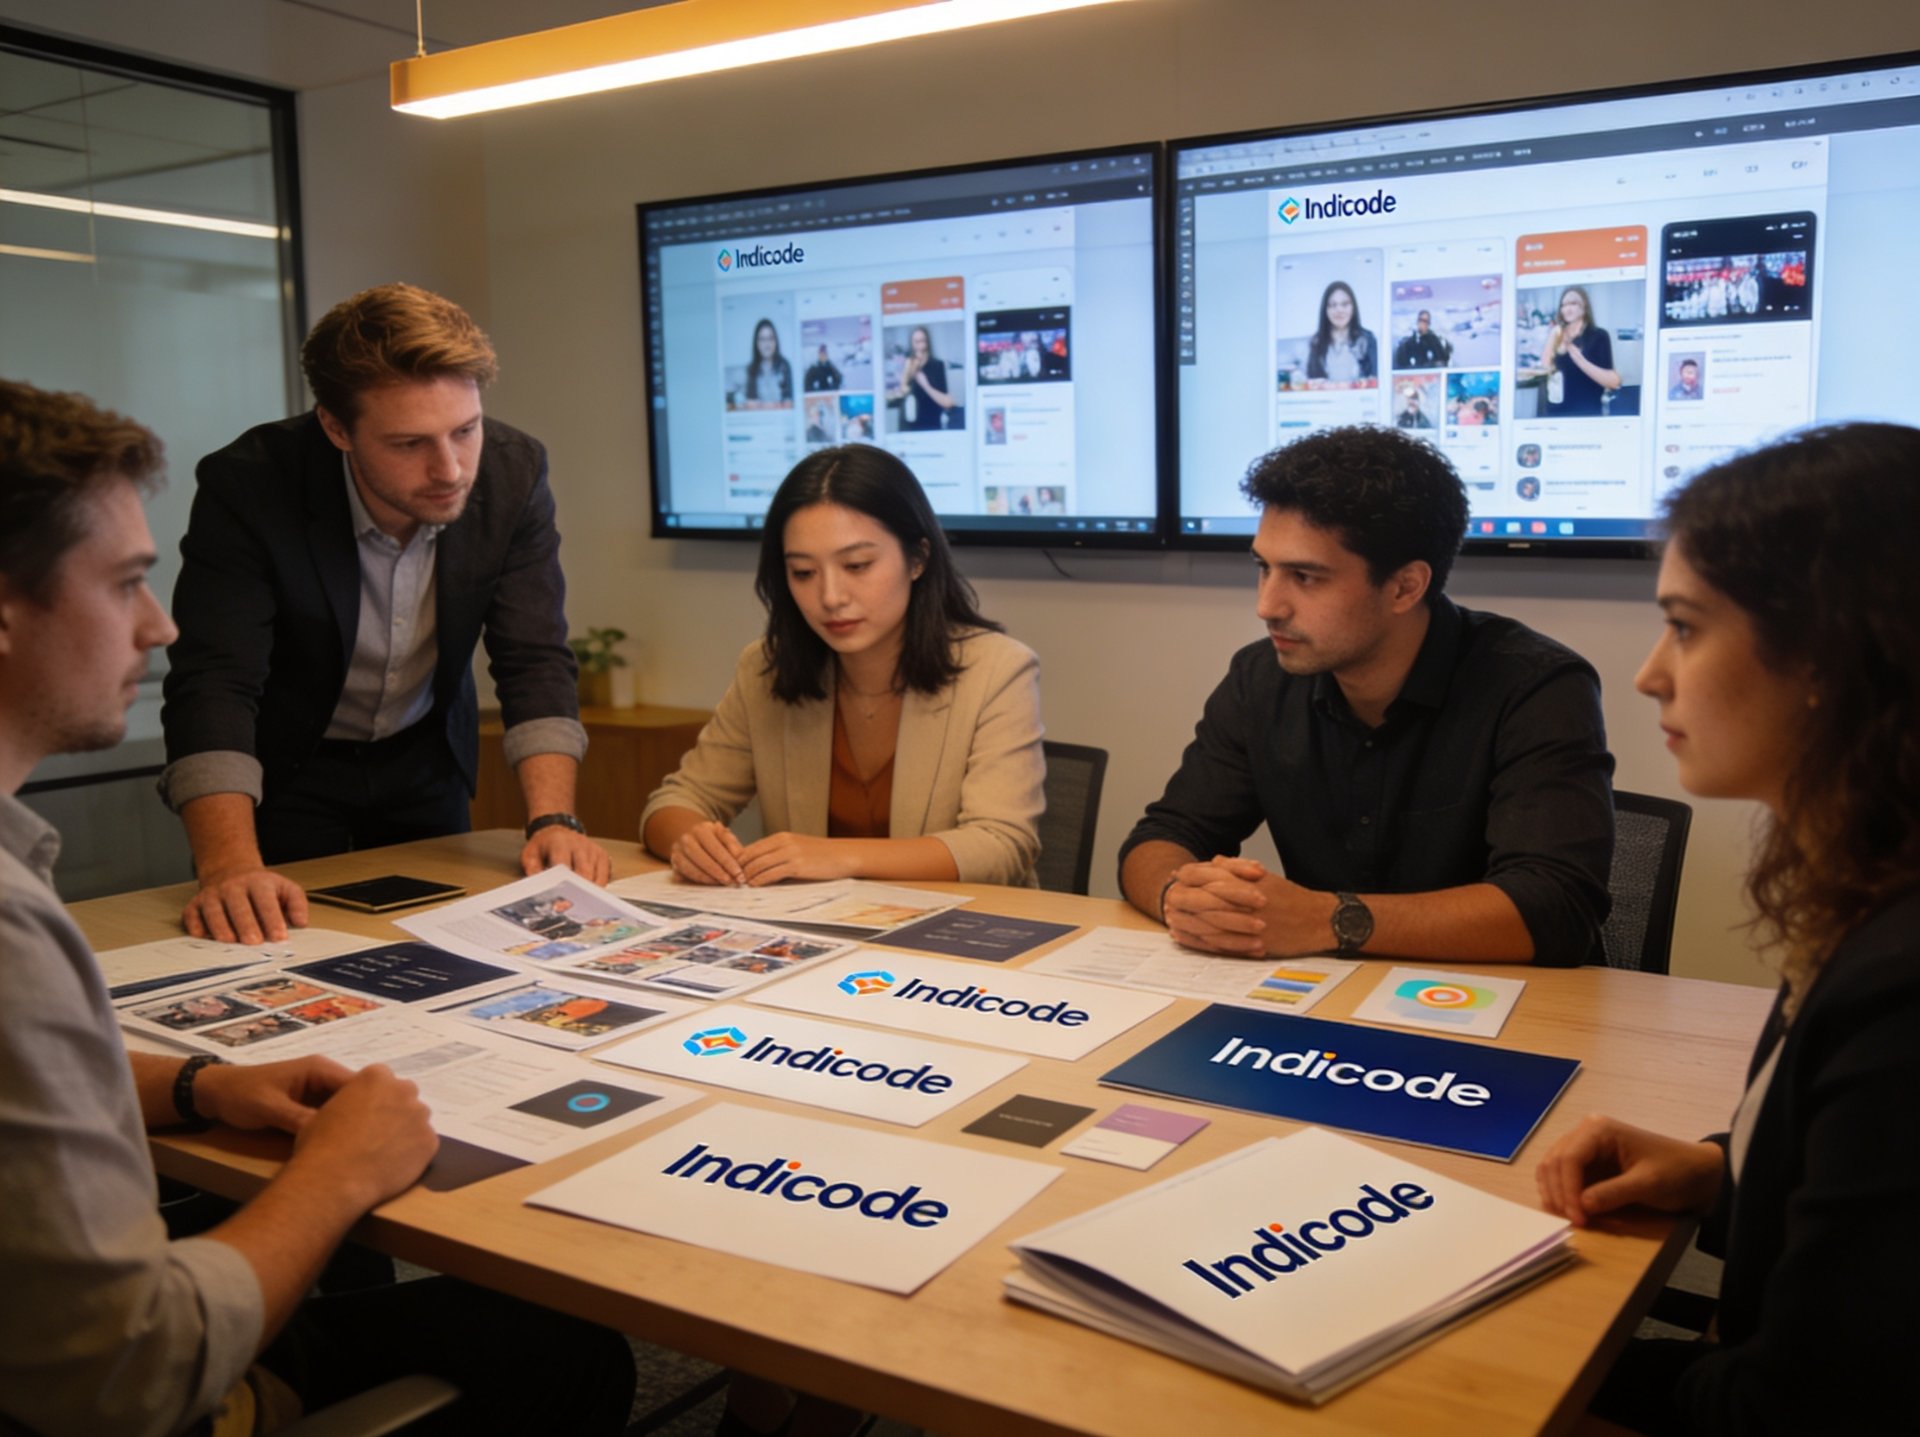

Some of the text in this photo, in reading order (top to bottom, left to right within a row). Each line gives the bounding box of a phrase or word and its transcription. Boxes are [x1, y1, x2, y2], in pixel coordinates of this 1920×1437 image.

[1304, 189, 1397, 220] Indicode
[735, 242, 804, 269] Indicode
[893, 977, 1090, 1028] Indicode
[740, 1036, 953, 1095] Indicode
[1209, 1037, 1491, 1108] Indicode
[661, 1144, 949, 1228] Indicode
[1182, 1181, 1436, 1300] Indicode
